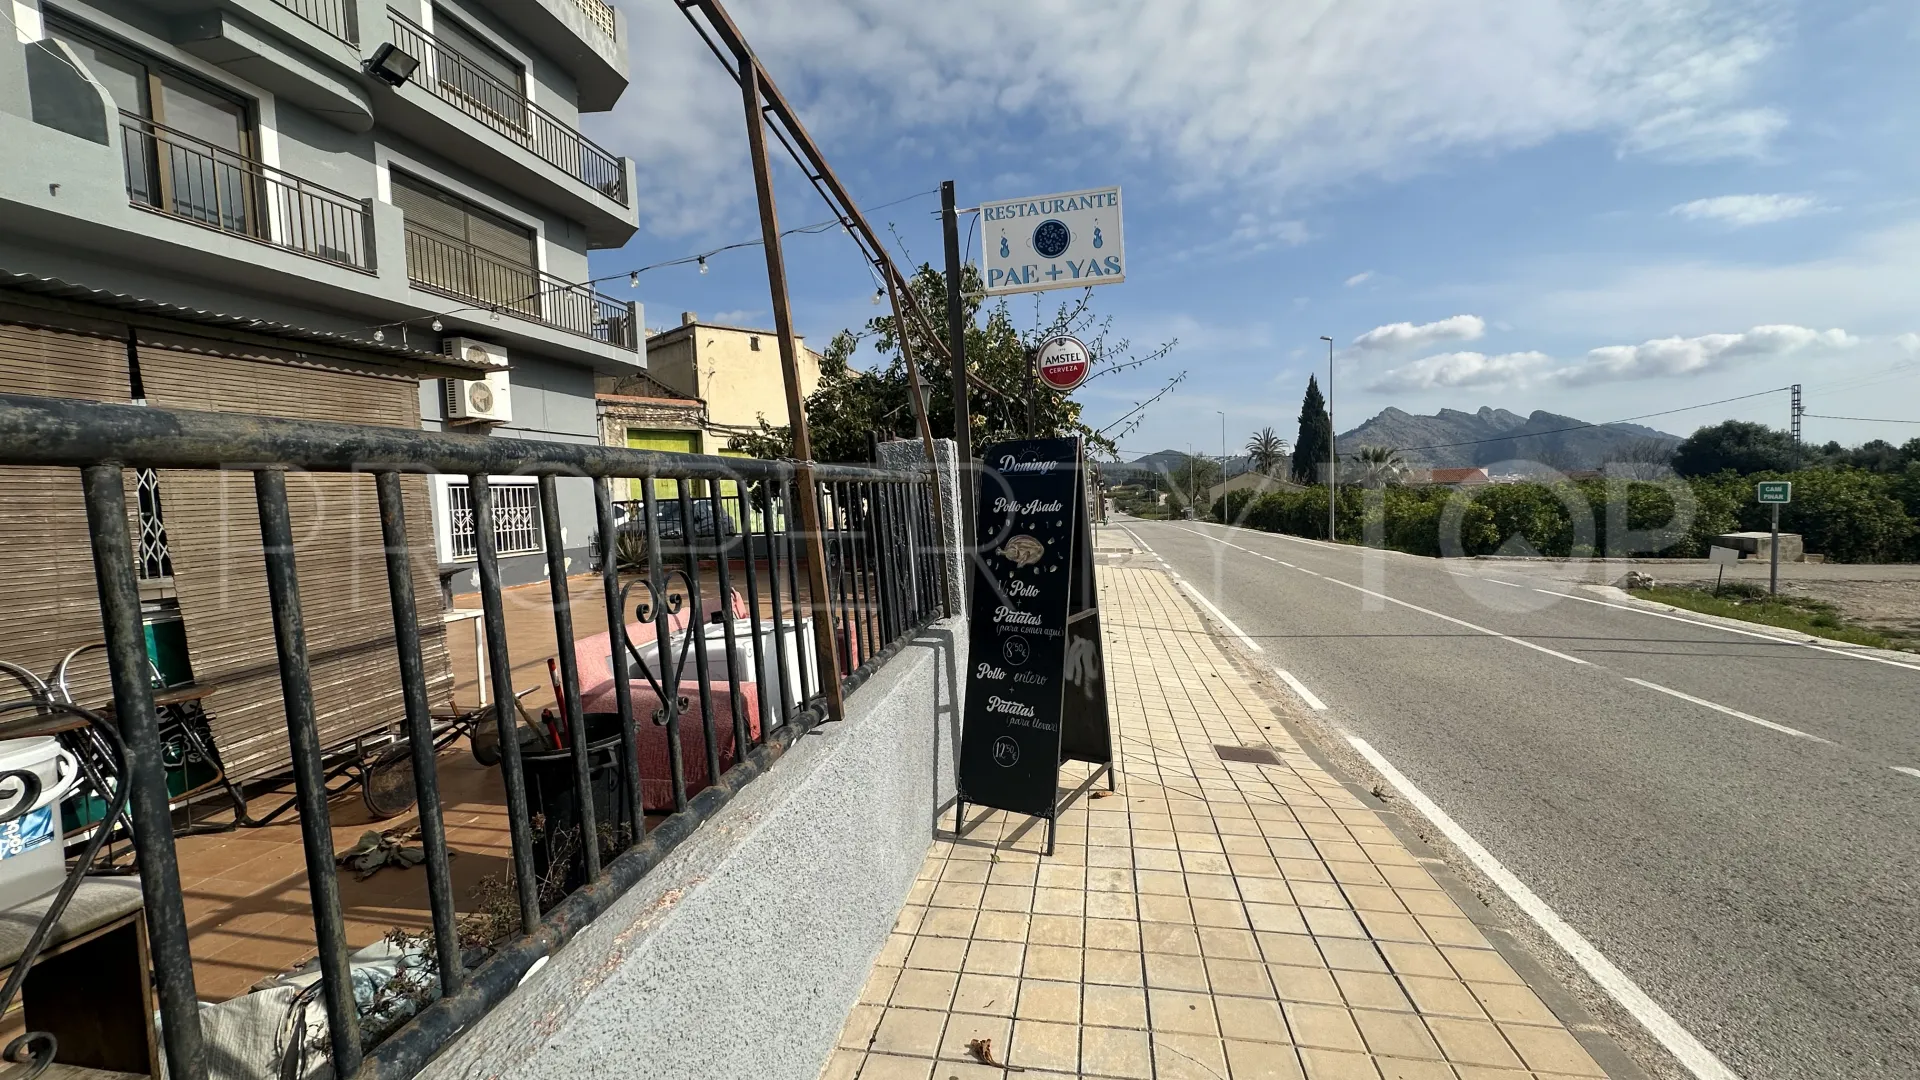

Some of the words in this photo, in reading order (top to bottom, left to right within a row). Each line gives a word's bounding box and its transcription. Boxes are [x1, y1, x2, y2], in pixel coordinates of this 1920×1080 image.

[983, 192, 1118, 221] RESTAURANTE
[987, 264, 1039, 287] PAE
[1065, 255, 1121, 278] YAS
[1045, 352, 1081, 365] AMSTEL
[1049, 365, 1077, 374] CERVEZA
[999, 454, 1058, 475] Domingo
[993, 497, 1021, 513] Pollo
[1021, 499, 1063, 514] Asado
[1009, 579, 1040, 597] Pollo
[993, 605, 1042, 625] Patatas
[1020, 626, 1042, 634] comer
[976, 662, 1006, 679] Pollo
[1013, 670, 1048, 685] entero
[986, 695, 1035, 717] Patatas
